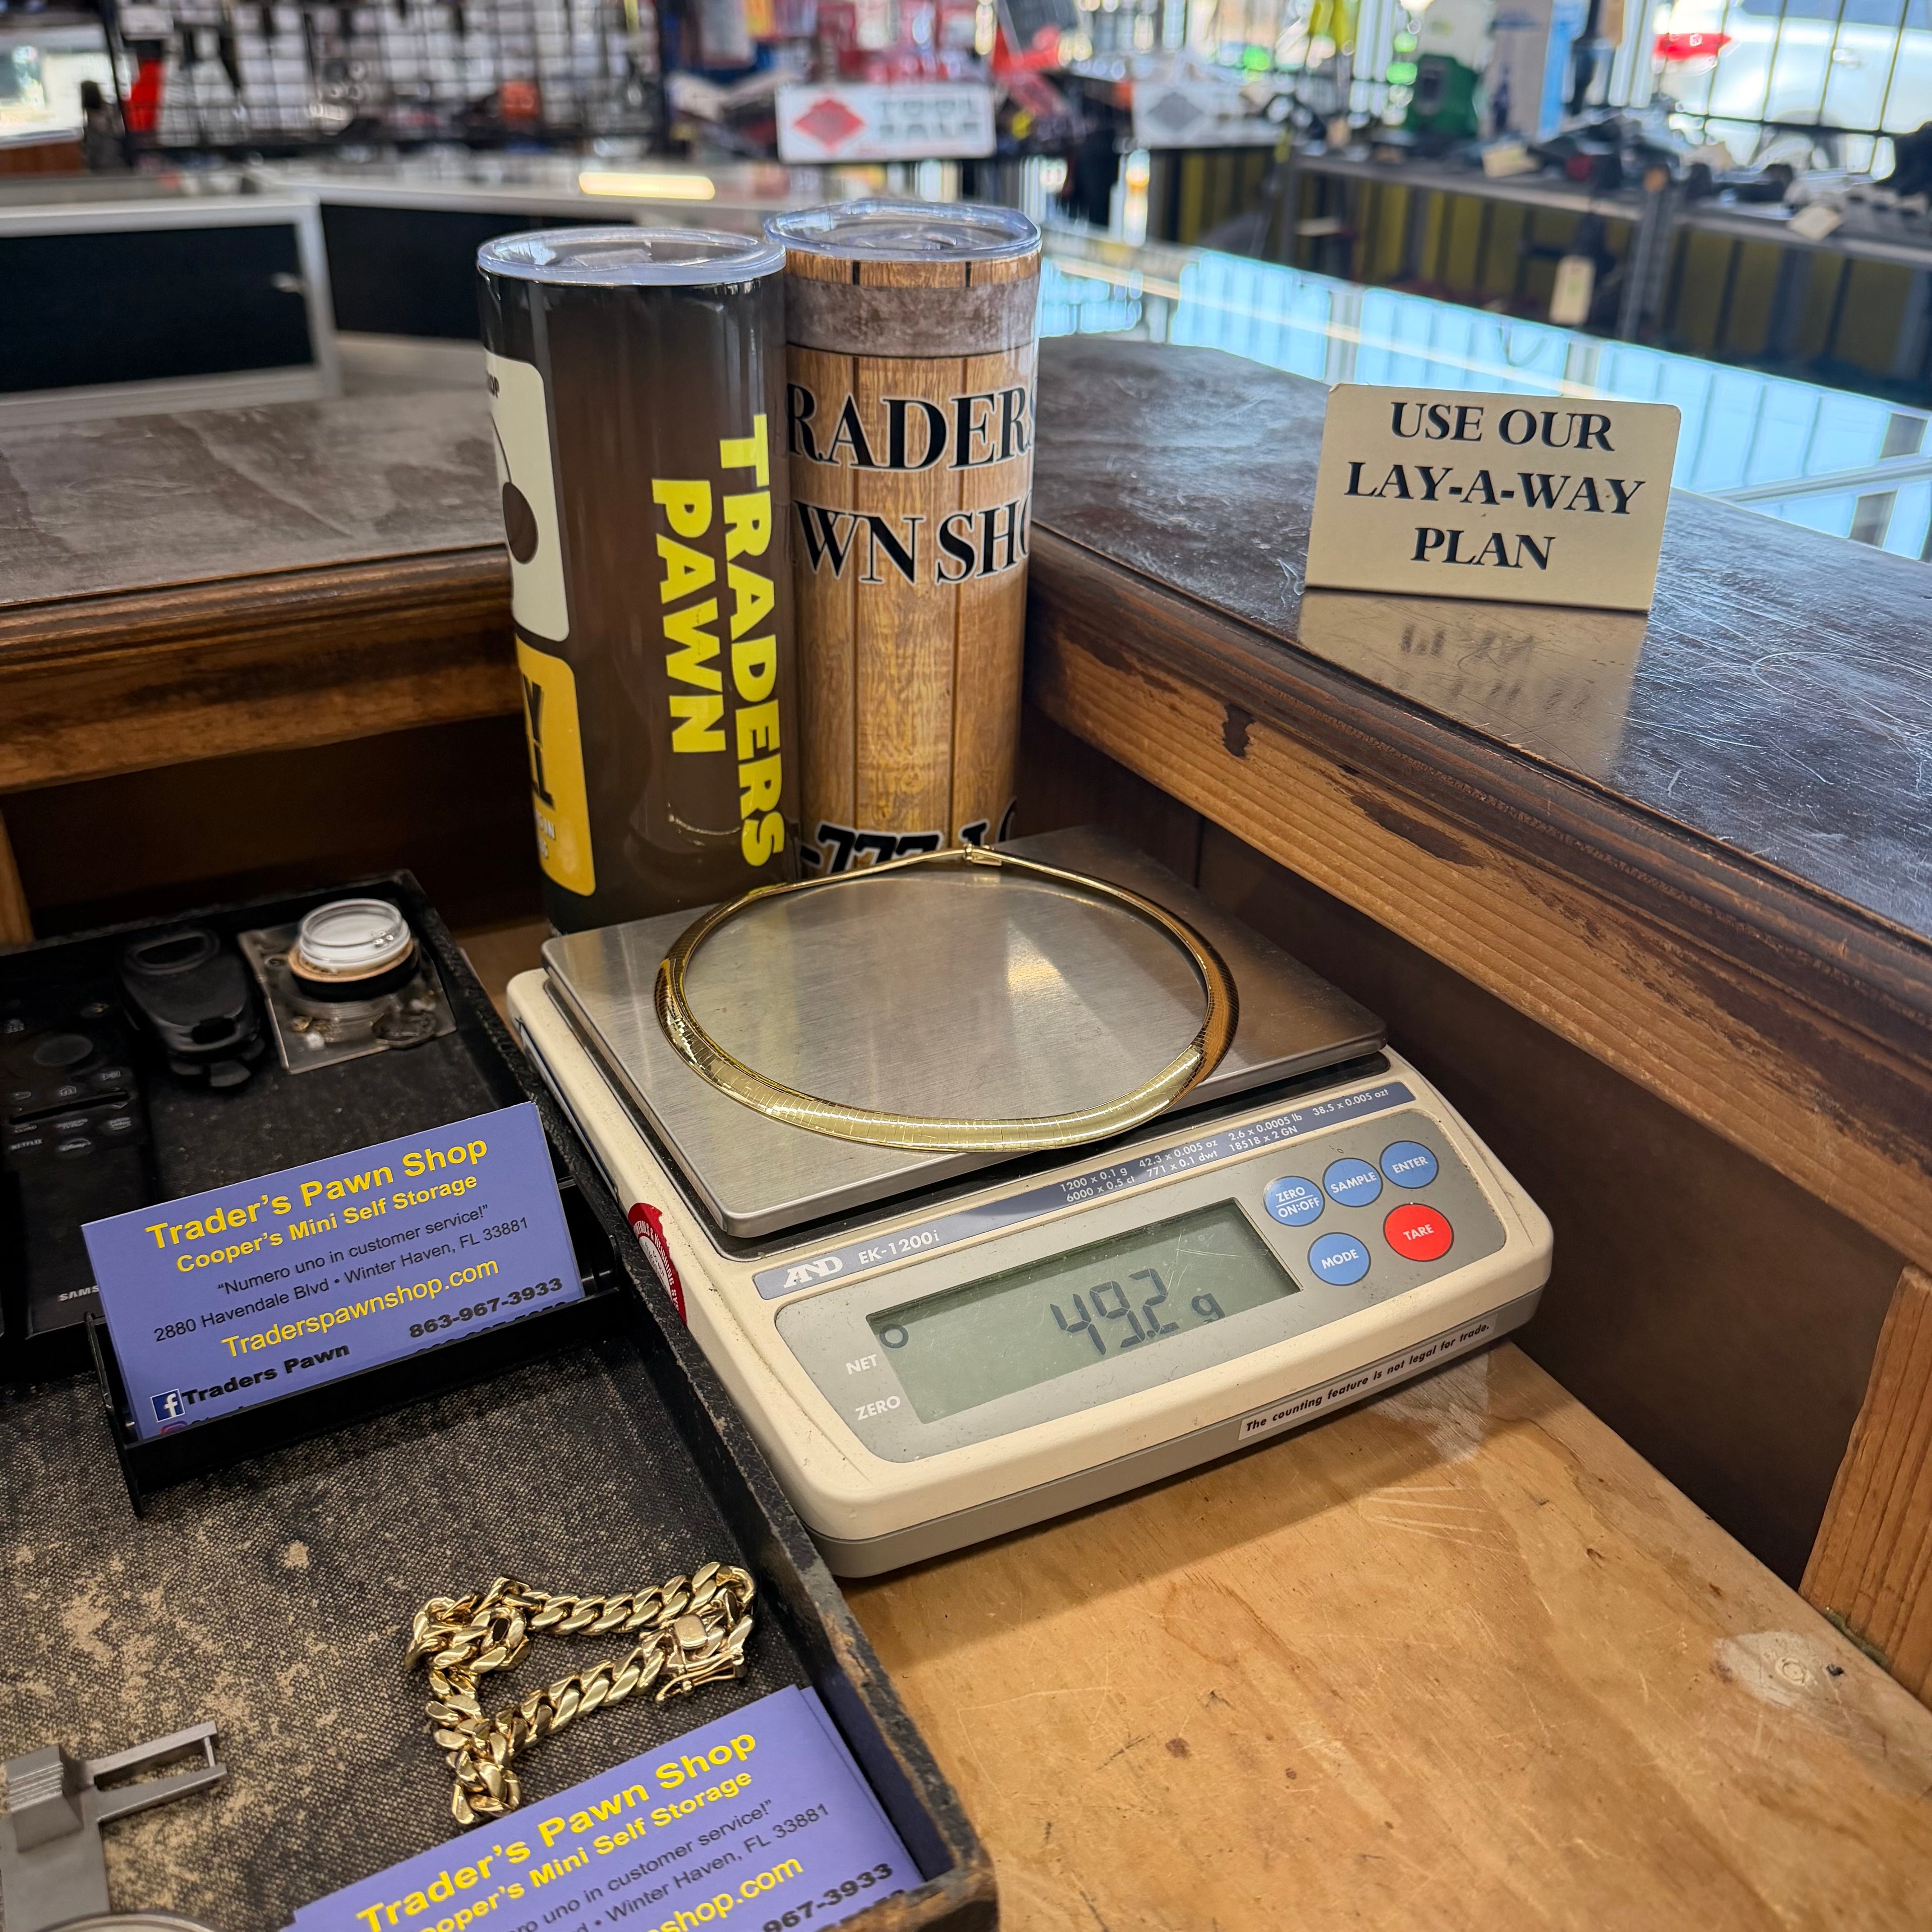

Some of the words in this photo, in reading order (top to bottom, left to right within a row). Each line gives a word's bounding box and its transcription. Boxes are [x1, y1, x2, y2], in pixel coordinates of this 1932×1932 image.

[786, 378, 1037, 470] RADER
[1391, 401, 1484, 442] USE
[1498, 409, 1615, 452] OUR
[1344, 461, 1646, 515] LAY-A-WAY
[1410, 527, 1556, 571] PLAN
[651, 478, 727, 753] PAWN
[719, 414, 785, 866] TRADERS
[1228, 1128, 1245, 1141] 2.6
[1247, 1128, 1255, 1136] x
[1256, 1116, 1291, 1133] 0.0005
[1292, 1113, 1303, 1122] lb
[1312, 1103, 1335, 1116] 38.5
[1337, 1102, 1344, 1110] x
[1344, 1092, 1373, 1107] 0.005
[1374, 1088, 1389, 1098] ozt
[1139, 1155, 1162, 1168] 42.3
[1173, 1142, 1203, 1158] 0.005
[1205, 1139, 1219, 1149] oz
[1146, 1164, 1166, 1178] 771
[1170, 1163, 1178, 1171] x
[1178, 1156, 1195, 1167] 0.1
[1198, 1150, 1218, 1162] dwt
[1228, 1136, 1261, 1152] 18518
[1263, 1135, 1271, 1143] x
[1273, 1130, 1280, 1140] 2
[1280, 1125, 1298, 1137] GN
[1060, 1177, 1088, 1192] 1200
[1090, 1175, 1098, 1184] x
[1099, 1168, 1117, 1181] 0.1
[1120, 1167, 1128, 1176] g
[1066, 1187, 1094, 1203] 6000
[1097, 1185, 1105, 1193] x
[1106, 1180, 1124, 1191] 0.5
[1126, 1175, 1136, 1184] ct
[1330, 1171, 1377, 1194] SAMPLE
[1392, 1156, 1429, 1174] ENTER
[145, 1194, 292, 1249] Trader’s
[299, 1166, 394, 1208] Pawn
[402, 1139, 488, 1177] Shop
[1275, 1186, 1306, 1203] ZERO
[177, 1232, 283, 1273] Cooper’s
[288, 1213, 338, 1241] Mini
[343, 1197, 387, 1225] Self
[392, 1175, 477, 1211] Storage
[1402, 1224, 1434, 1241] TARE
[295, 1256, 326, 1274] uno
[330, 1250, 345, 1263] in
[349, 1226, 421, 1258] customer
[1321, 1248, 1359, 1269] MODE
[153, 1318, 196, 1342] 2880
[201, 1292, 290, 1328] Havendale
[293, 1278, 330, 1301] Blvd
[344, 1258, 396, 1283] Winter
[400, 1241, 456, 1267] Haven,
[459, 1233, 480, 1249] FL
[482, 1217, 528, 1241] 33881
[220, 1259, 499, 1358] Traderspawnshop.com
[409, 1277, 563, 1338] 863-967-3933
[1050, 1267, 1180, 1355] 49.2
[1191, 1293, 1226, 1324] g
[181, 1367, 278, 1405] Traders
[284, 1344, 351, 1374] Pawn
[845, 1354, 877, 1375] NET
[1246, 1416, 1267, 1432] The
[1272, 1395, 1322, 1422] counting
[1327, 1376, 1369, 1400] feature
[1373, 1369, 1382, 1381] is
[1387, 1359, 1405, 1375] not
[1409, 1345, 1436, 1366] legal
[1440, 1338, 1456, 1351] for
[1459, 1323, 1490, 1342] trade.
[855, 1395, 901, 1421] ZERO
[355, 1844, 531, 1932] Trader’s
[538, 1784, 650, 1847] Pawn
[655, 1733, 756, 1789] Shop
[529, 1846, 589, 1888] Mini
[593, 1817, 647, 1855] Self
[651, 1773, 752, 1827] Storage
[542, 1899, 580, 1924] uno
[583, 1887, 604, 1903] in
[607, 1841, 693, 1892] customer
[605, 1883, 670, 1922] Winter
[672, 1852, 742, 1889] Haven,
[743, 1834, 772, 1854] FL
[772, 1803, 830, 1838] 33881
